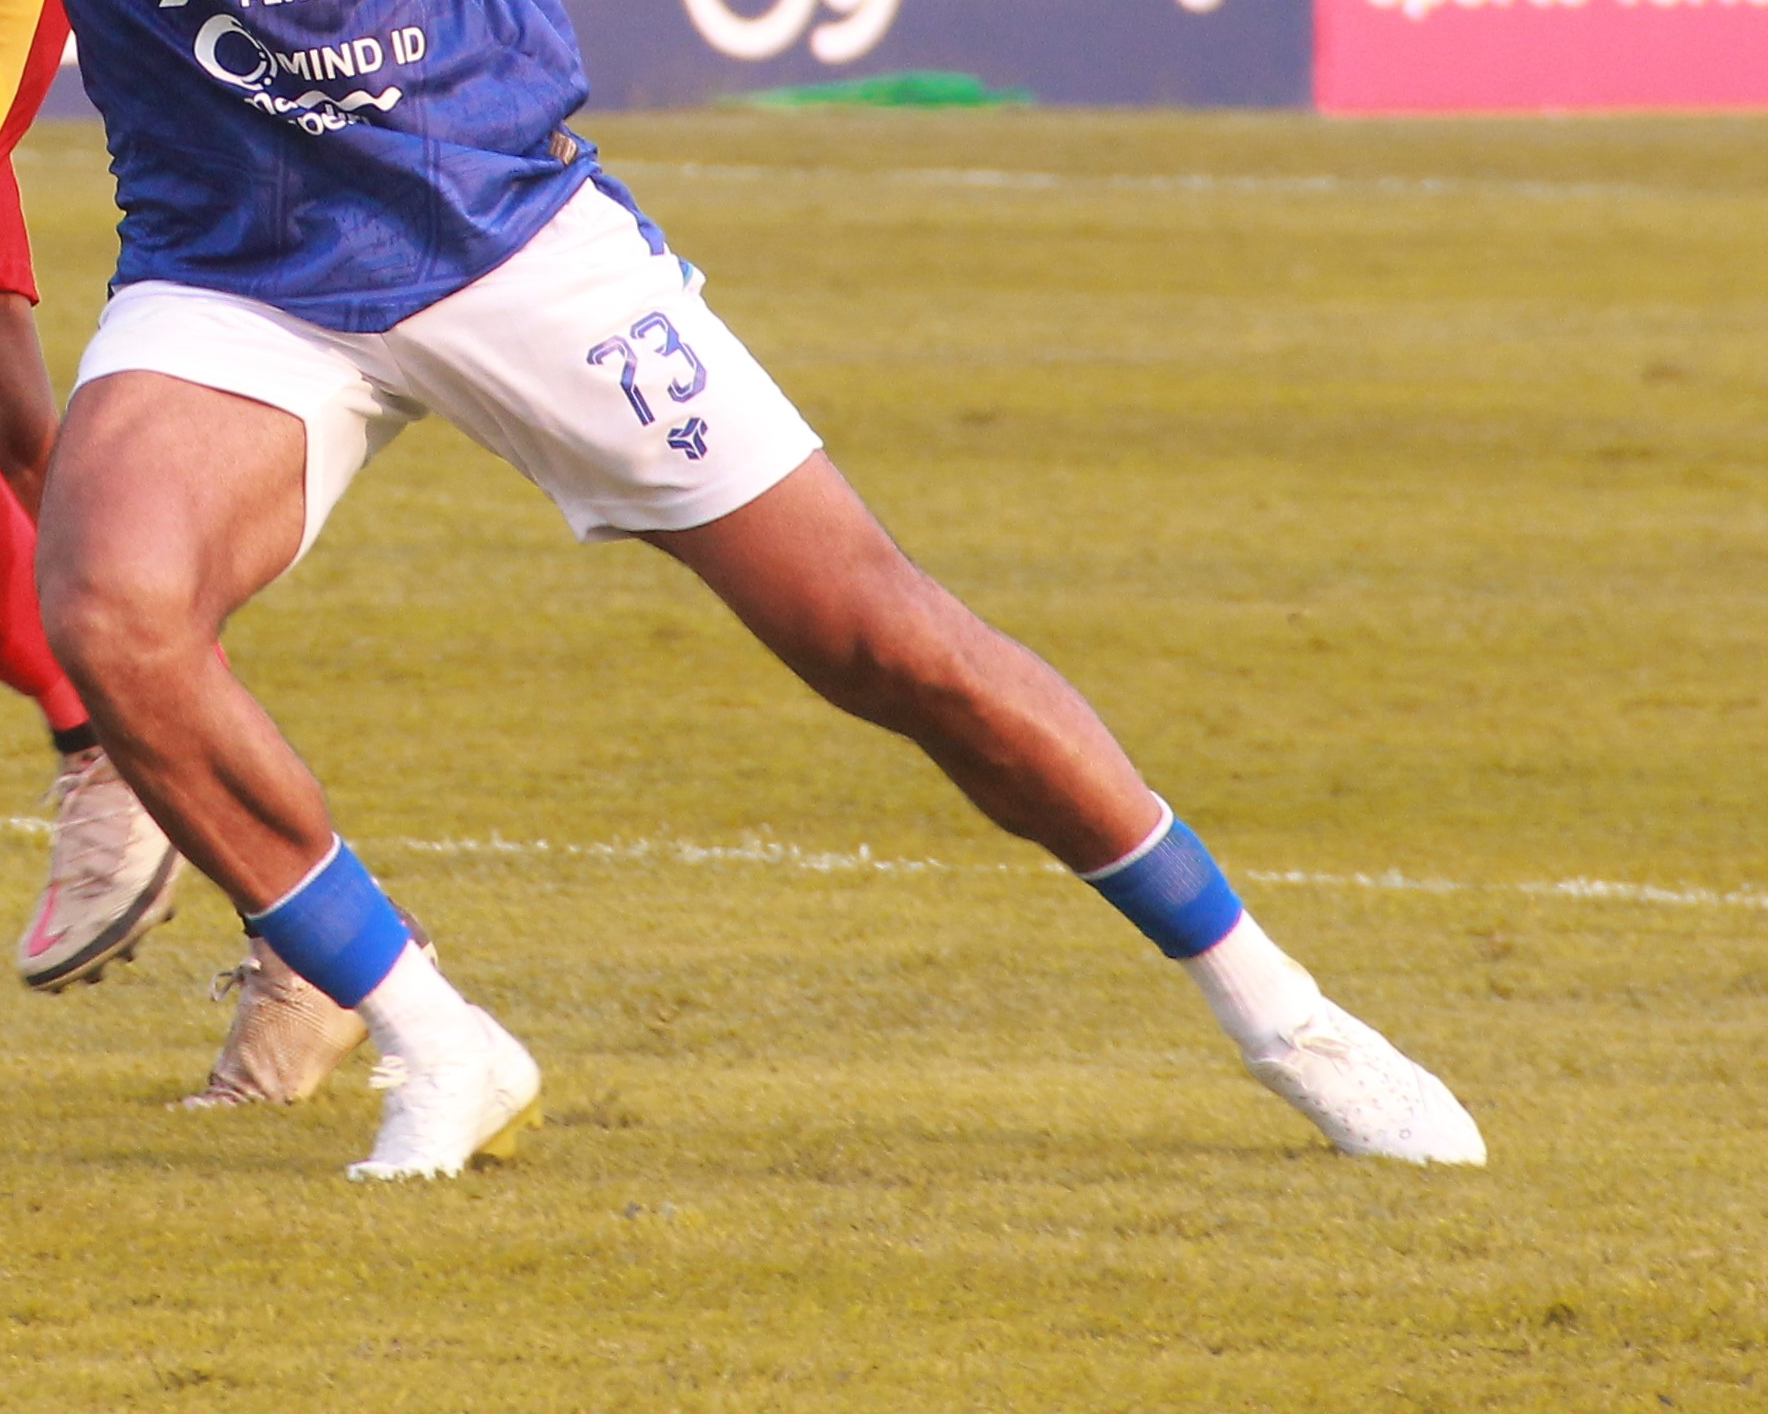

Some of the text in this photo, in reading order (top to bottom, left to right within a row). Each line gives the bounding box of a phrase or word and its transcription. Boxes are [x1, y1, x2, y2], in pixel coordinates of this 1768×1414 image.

[275, 26, 427, 81] MIND ID
[586, 311, 707, 427] 73
